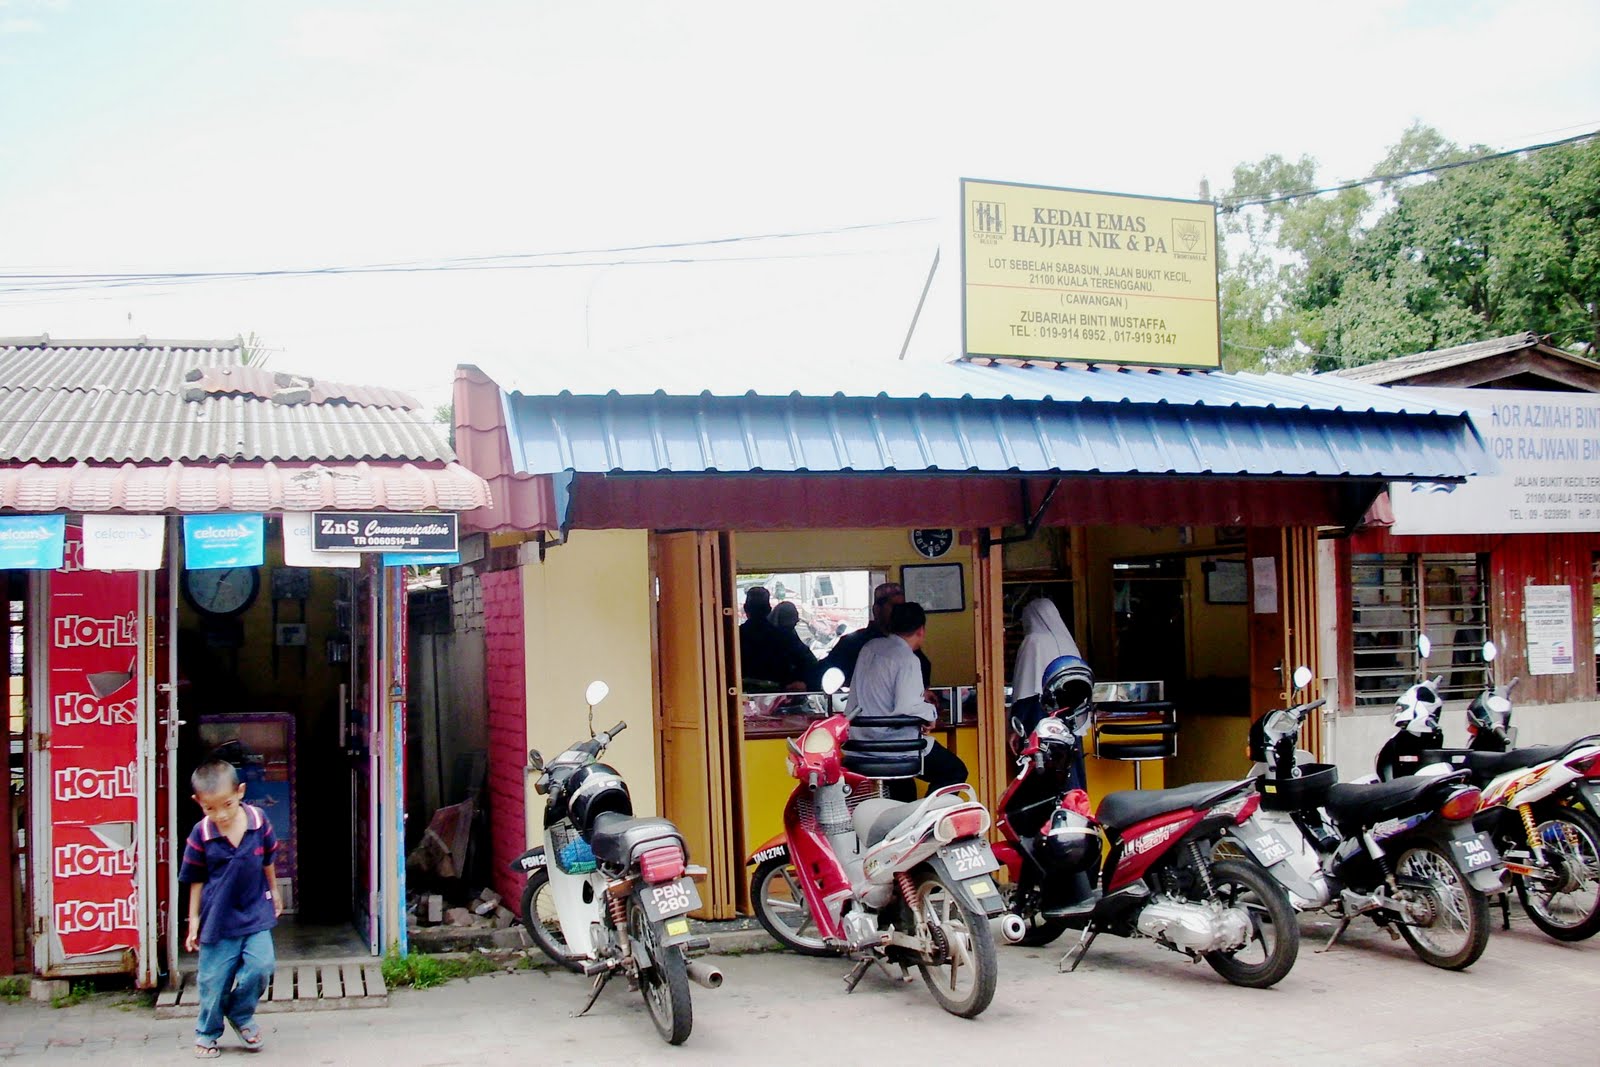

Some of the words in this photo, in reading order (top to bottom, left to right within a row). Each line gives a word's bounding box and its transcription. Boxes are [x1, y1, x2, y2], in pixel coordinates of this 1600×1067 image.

[1033, 207, 1091, 228] KEDAI
[1096, 213, 1146, 233] EMAS
[1012, 225, 1082, 248] HAJJAH
[1088, 231, 1121, 249] NIK
[1127, 234, 1140, 251] &
[1144, 236, 1168, 253] PA
[988, 258, 1007, 269] LOT
[1009, 259, 1053, 273] SEBELAH
[1104, 266, 1133, 279] JALAN
[1136, 268, 1162, 280] BUKIT
[1164, 271, 1193, 285] KECIL,
[1029, 273, 1055, 286] 21100
[1057, 276, 1089, 288] KUALA
[1020, 311, 1077, 325] ZUBARIAH
[1080, 314, 1108, 327] BINTI
[1110, 316, 1167, 330] MUSTAFFA
[1010, 325, 1031, 337] TEL
[1040, 326, 1079, 340] 019-914
[1082, 328, 1106, 341] 6952
[1114, 331, 1152, 344] 017-919
[1154, 333, 1177, 345] 3147
[1492, 404, 1522, 429] NOR
[1525, 404, 1571, 429] AZMAH
[1518, 437, 1579, 461] RAJWANI
[1514, 476, 1538, 488] JALAN
[1540, 476, 1562, 488] BUKIT
[1548, 493, 1573, 504] KUALA
[1574, 493, 1600, 504] TEREN
[0, 527, 39, 541] elcom
[95, 527, 136, 539] celcom
[194, 525, 239, 540] celcom
[293, 524, 311, 537] cel
[321, 519, 360, 535] ZnS
[364, 519, 449, 537] Communication
[353, 536, 367, 546] TR
[752, 850, 768, 865] TAN
[767, 845, 785, 859] 2741
[951, 844, 979, 859] TAN
[1462, 840, 1484, 854] TAA
[521, 853, 540, 869] PBN
[956, 854, 987, 873] 2741
[1464, 850, 1492, 868] 7910
[657, 895, 690, 916] 280
